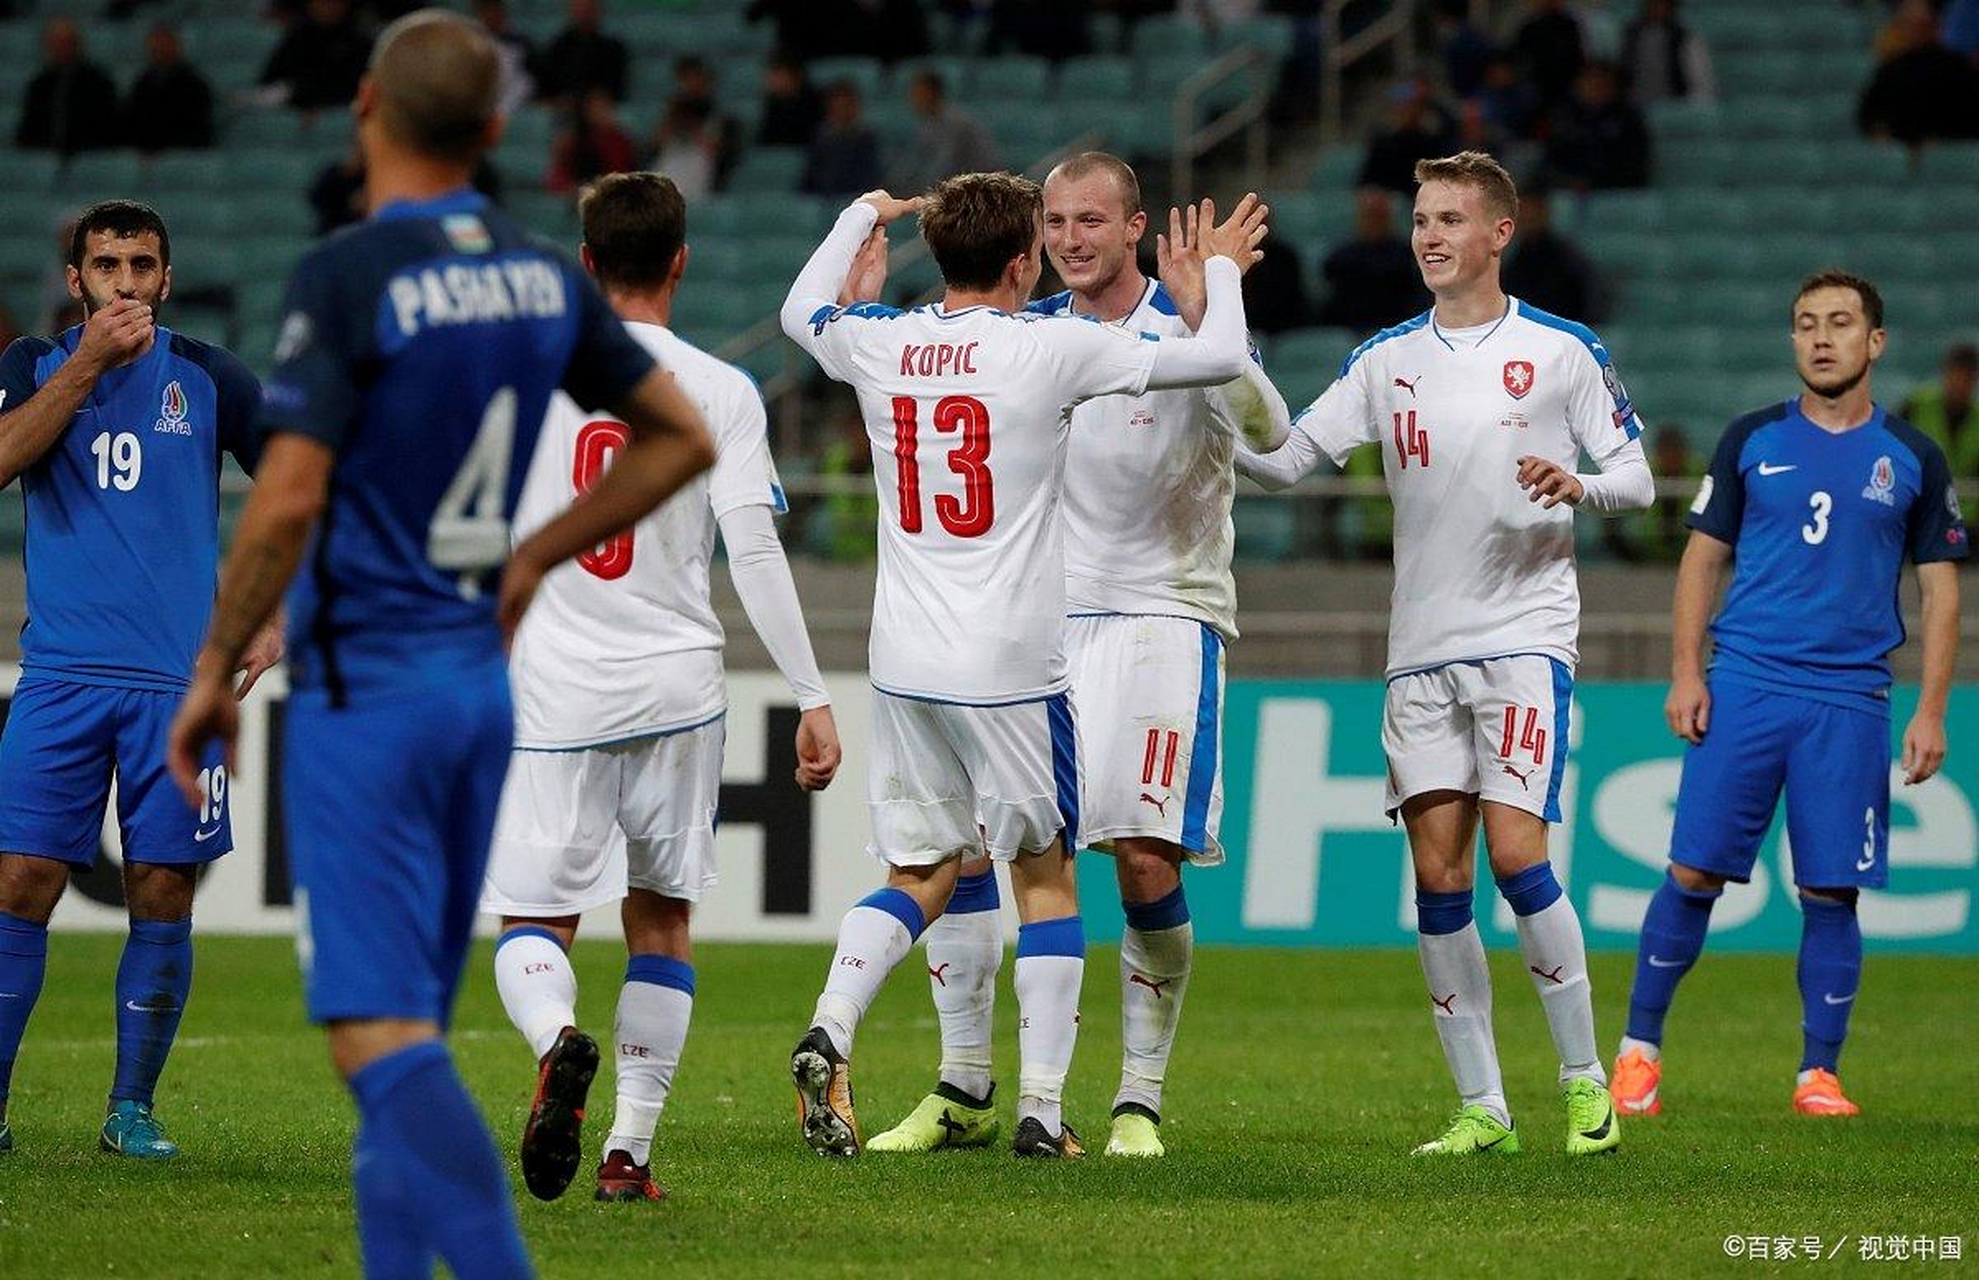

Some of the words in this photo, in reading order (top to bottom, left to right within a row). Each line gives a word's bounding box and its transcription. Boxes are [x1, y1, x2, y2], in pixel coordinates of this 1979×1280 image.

[154, 418, 192, 436] AFFA
[1393, 410, 1429, 470] 14
[91, 431, 141, 492] 19
[428, 385, 516, 570] 4
[892, 394, 995, 539] 13
[1802, 491, 1832, 545] 3
[1142, 729, 1178, 788] 11
[1501, 705, 1546, 765] 14
[195, 764, 226, 824] 19
[1863, 806, 1875, 860] 3
[621, 1043, 651, 1058] CZE
